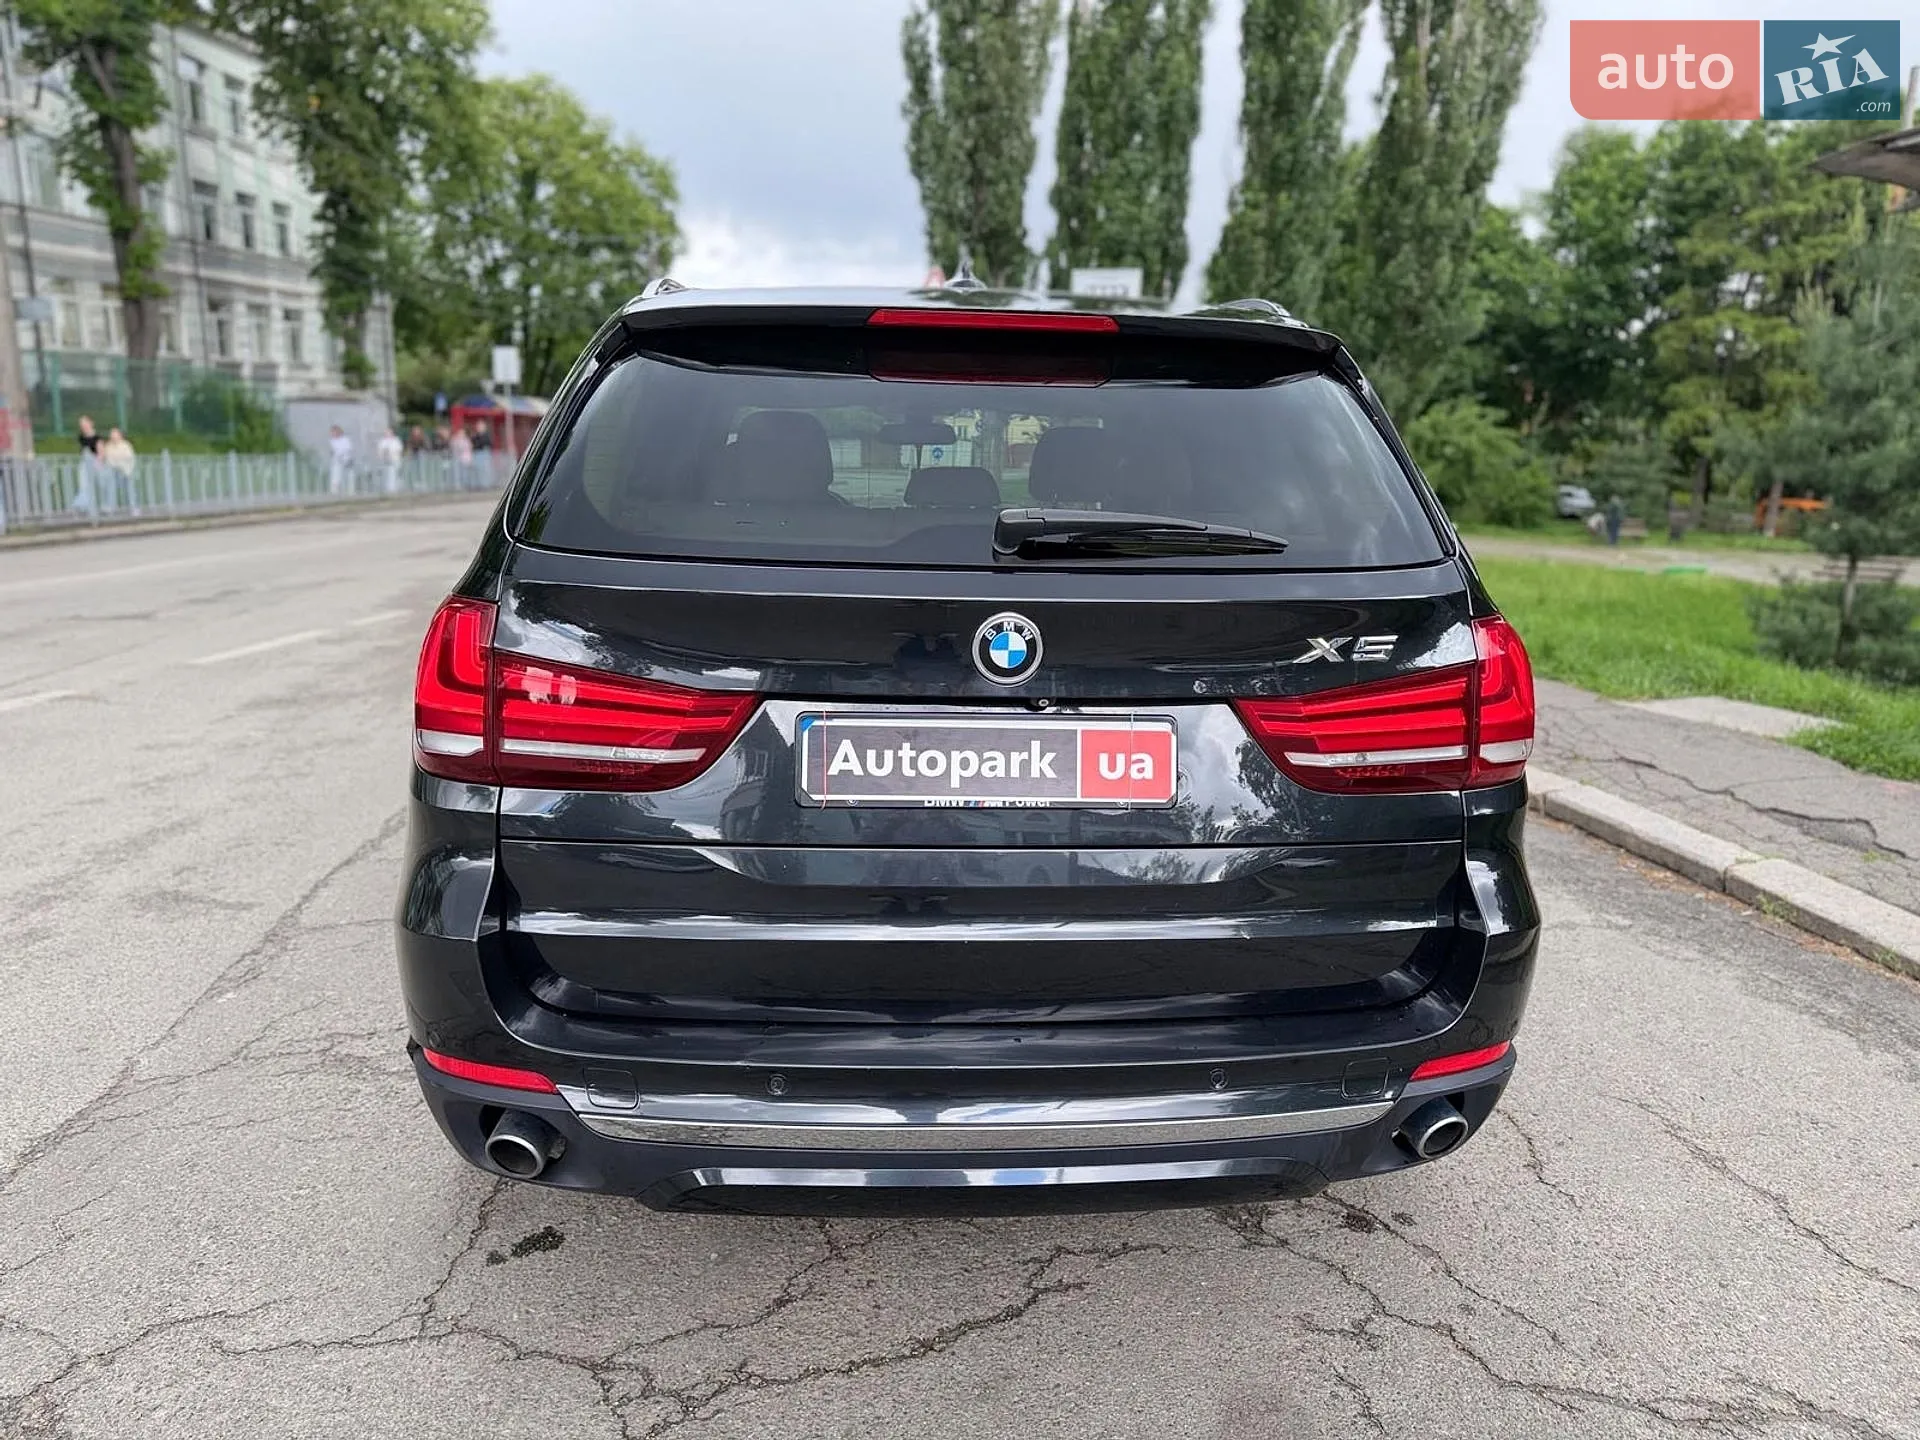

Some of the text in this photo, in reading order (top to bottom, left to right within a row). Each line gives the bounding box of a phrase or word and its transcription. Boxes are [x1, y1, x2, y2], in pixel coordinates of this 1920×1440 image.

[985, 621, 1034, 641] BMW
[1292, 634, 1399, 664] X5
[827, 739, 1154, 789] Autopark ua
